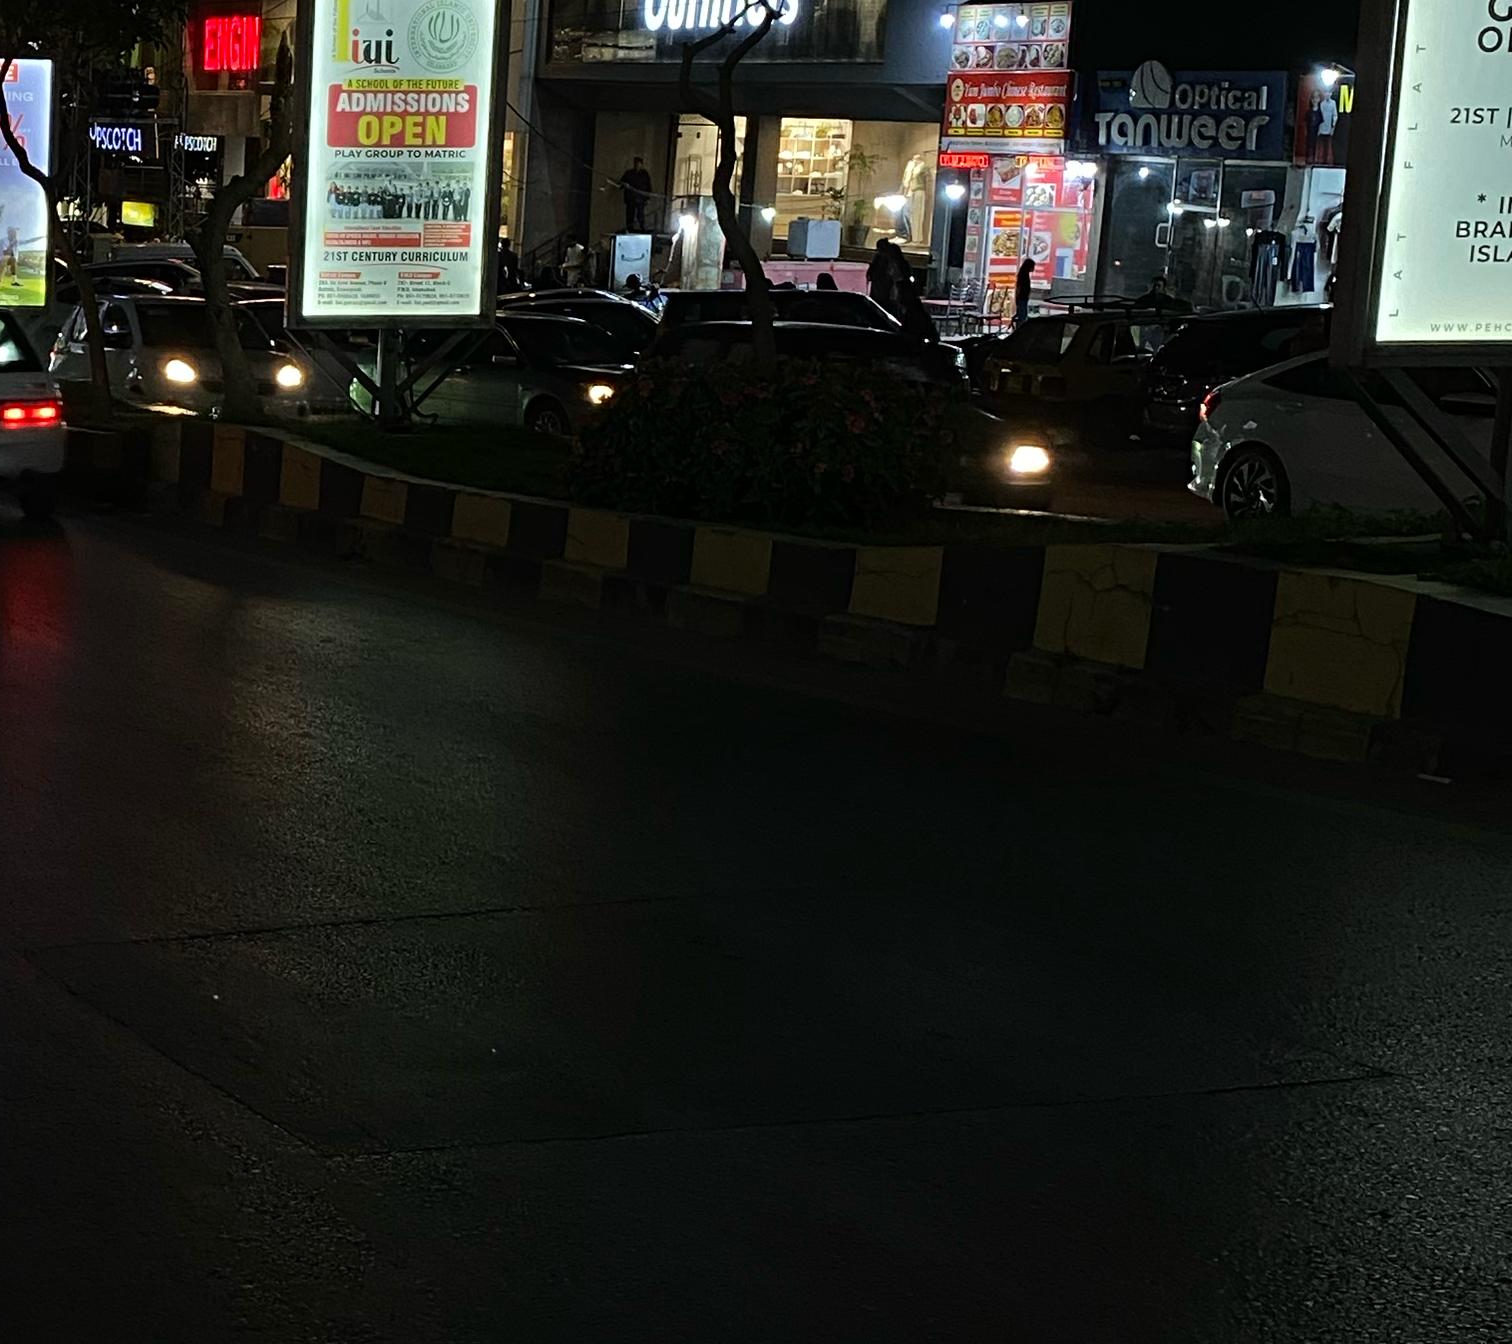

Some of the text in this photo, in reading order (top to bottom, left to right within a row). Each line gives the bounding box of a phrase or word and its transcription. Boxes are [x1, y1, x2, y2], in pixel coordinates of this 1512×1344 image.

[348, 80, 459, 89] A SCHOOL OF THE FUTURE
[336, 93, 470, 113] ADMISSIONS
[1450, 107, 1499, 125] 21ST
[358, 115, 447, 146] OPEN
[335, 150, 466, 159] PLAY GROUP TO MATRIC
[324, 251, 468, 262] 21ST CENTURY CURRICULUM
